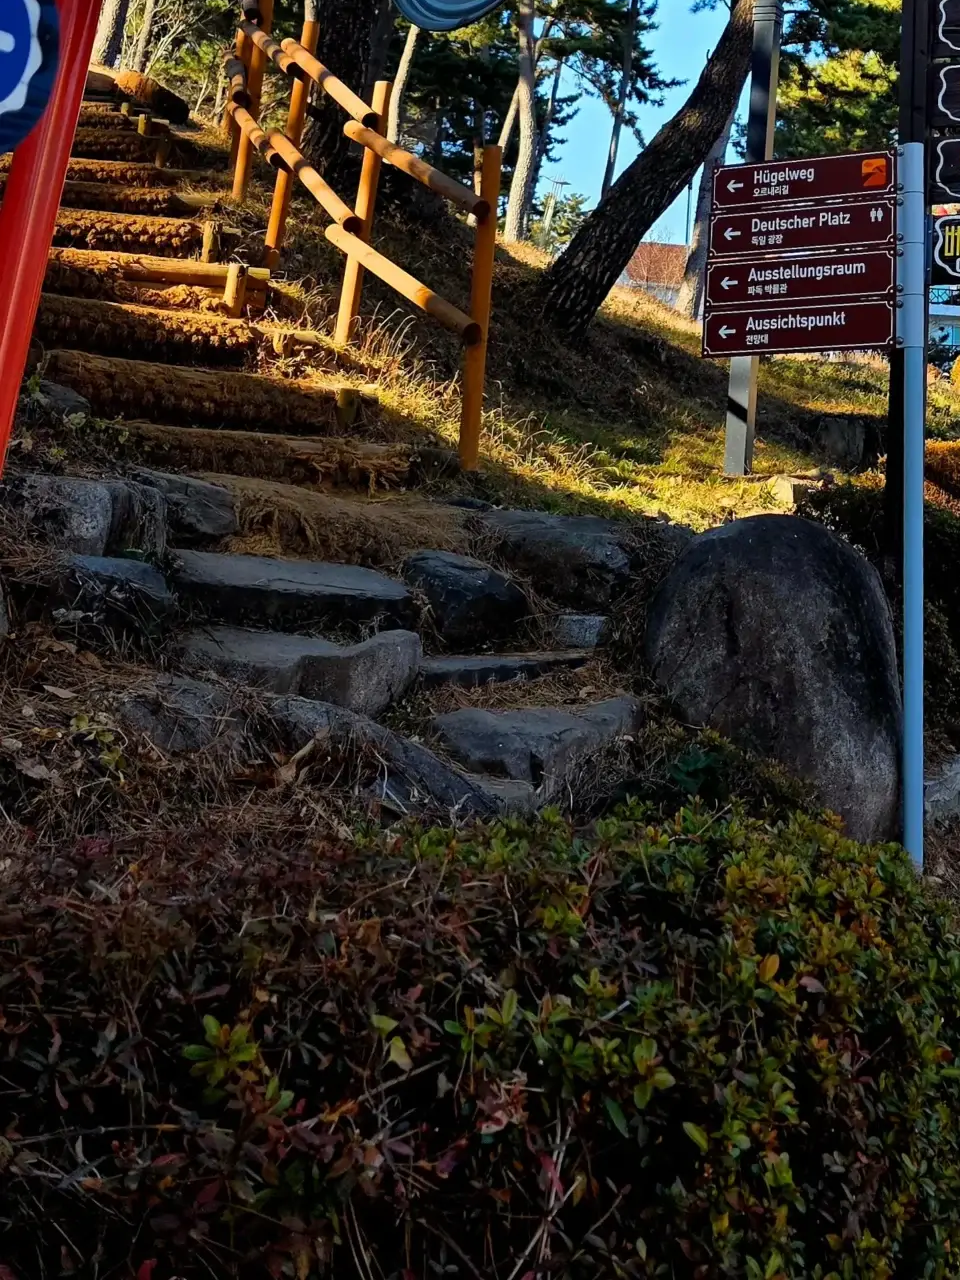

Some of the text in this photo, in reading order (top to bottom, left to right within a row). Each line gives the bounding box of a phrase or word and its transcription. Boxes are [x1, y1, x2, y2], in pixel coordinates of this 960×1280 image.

[753, 167, 815, 186] Hügelweg
[753, 185, 789, 197] 오르내리길
[751, 211, 850, 232] Deutscher Platz
[751, 234, 783, 246] 독일 광장
[748, 262, 865, 282] Ausstellungsraum
[746, 311, 846, 331] Aussichtspunkt
[745, 333, 769, 345] 전망대
